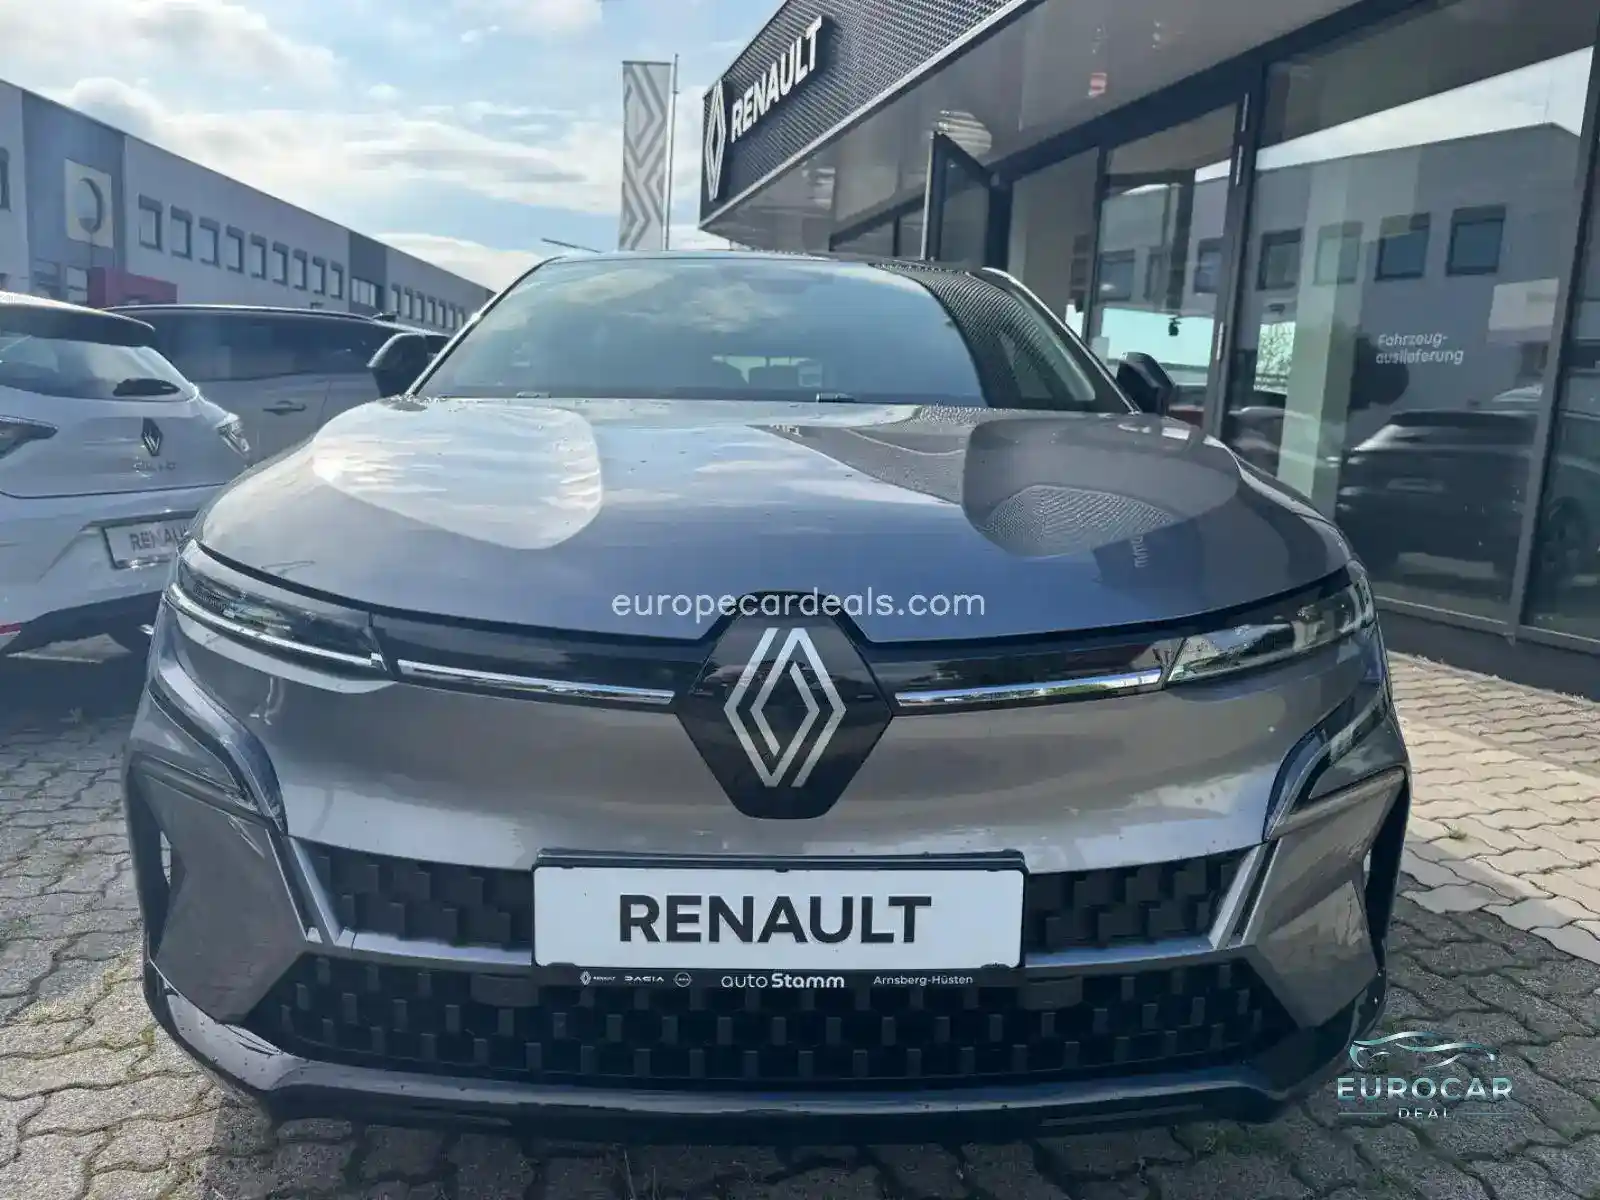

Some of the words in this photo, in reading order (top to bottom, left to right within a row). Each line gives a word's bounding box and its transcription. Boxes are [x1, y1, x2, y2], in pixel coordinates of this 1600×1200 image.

[731, 15, 822, 143] RENAULT
[1377, 332, 1449, 348] Fahrzeug-
[619, 894, 933, 944] RENAULT
[721, 973, 769, 989] auto
[771, 972, 846, 989] Stamm
[873, 974, 974, 987] Arnsberg-Hüsten
